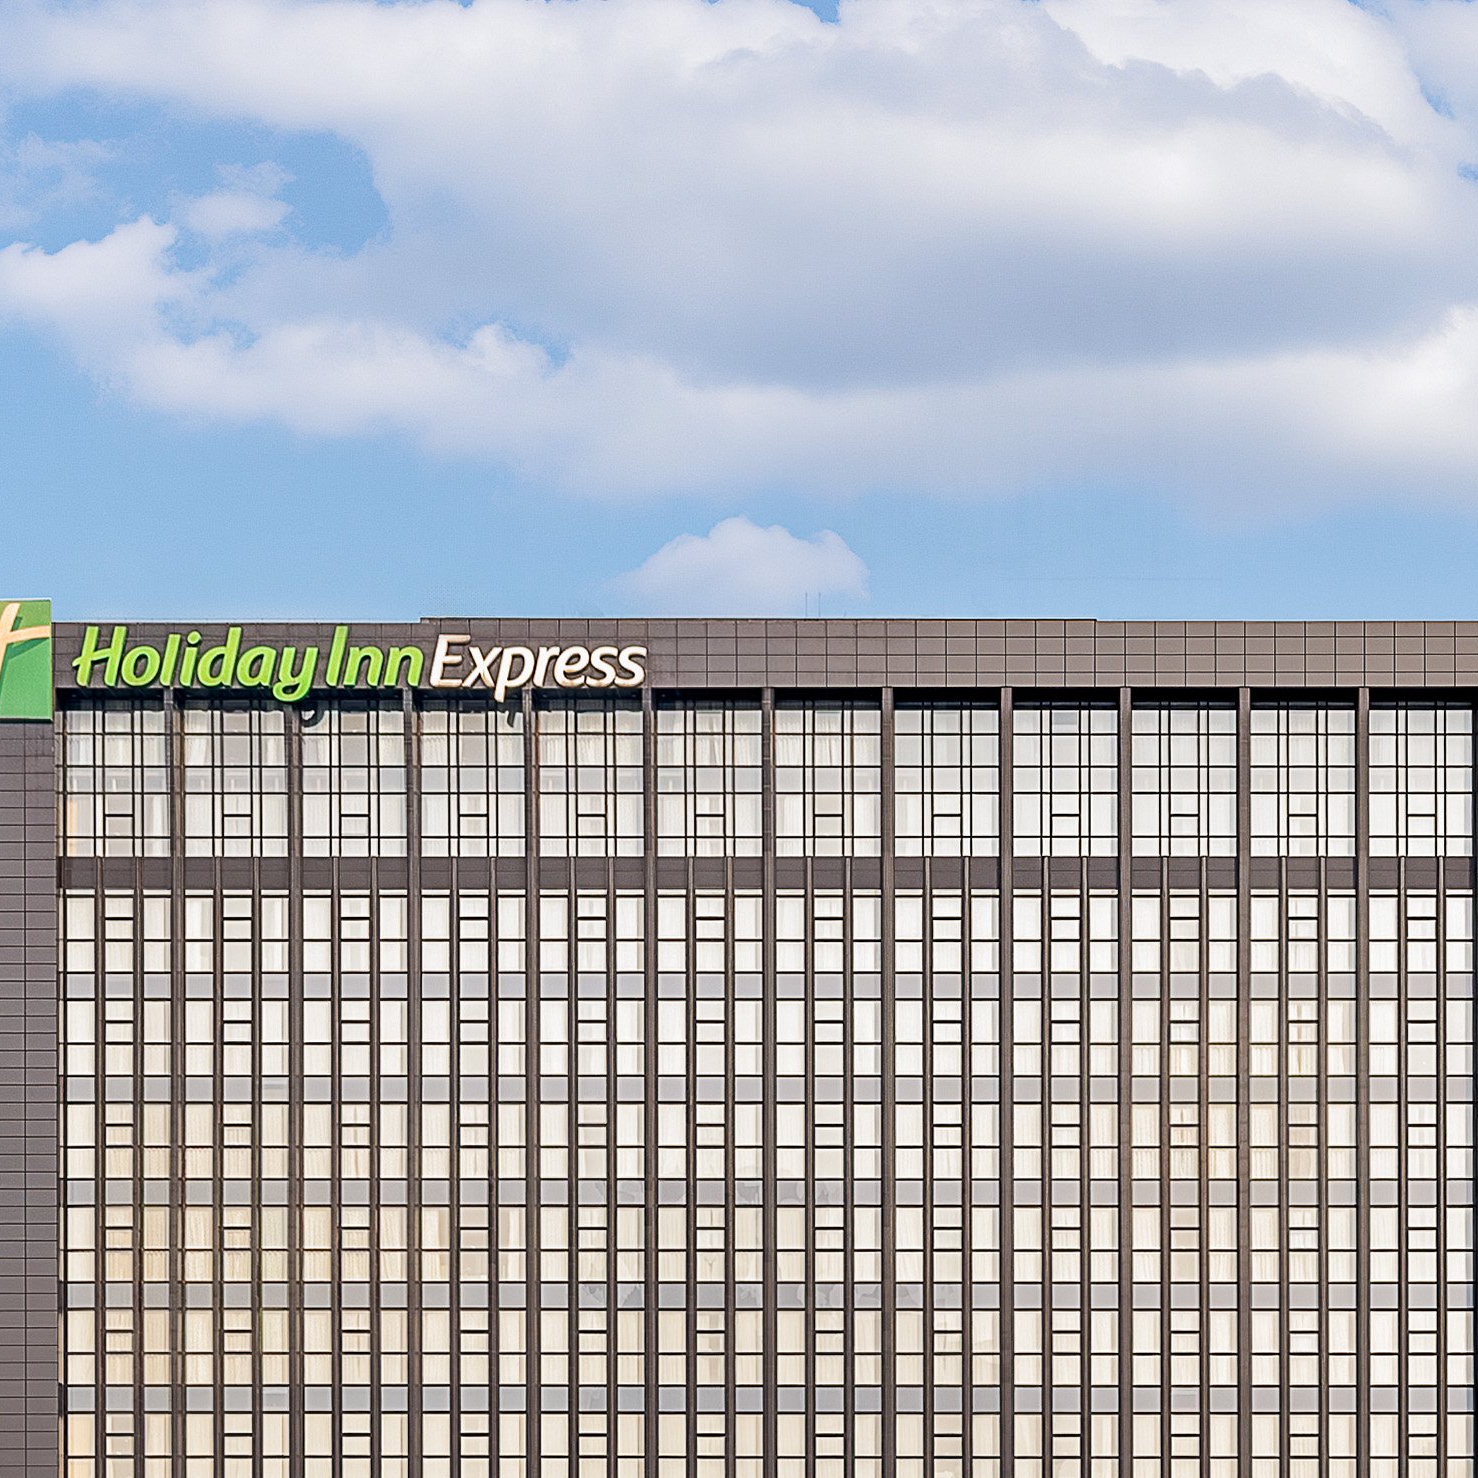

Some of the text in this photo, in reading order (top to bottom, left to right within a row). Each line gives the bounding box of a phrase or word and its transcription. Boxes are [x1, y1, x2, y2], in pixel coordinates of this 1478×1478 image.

[72, 625, 648, 703] Holiday Inn Express
